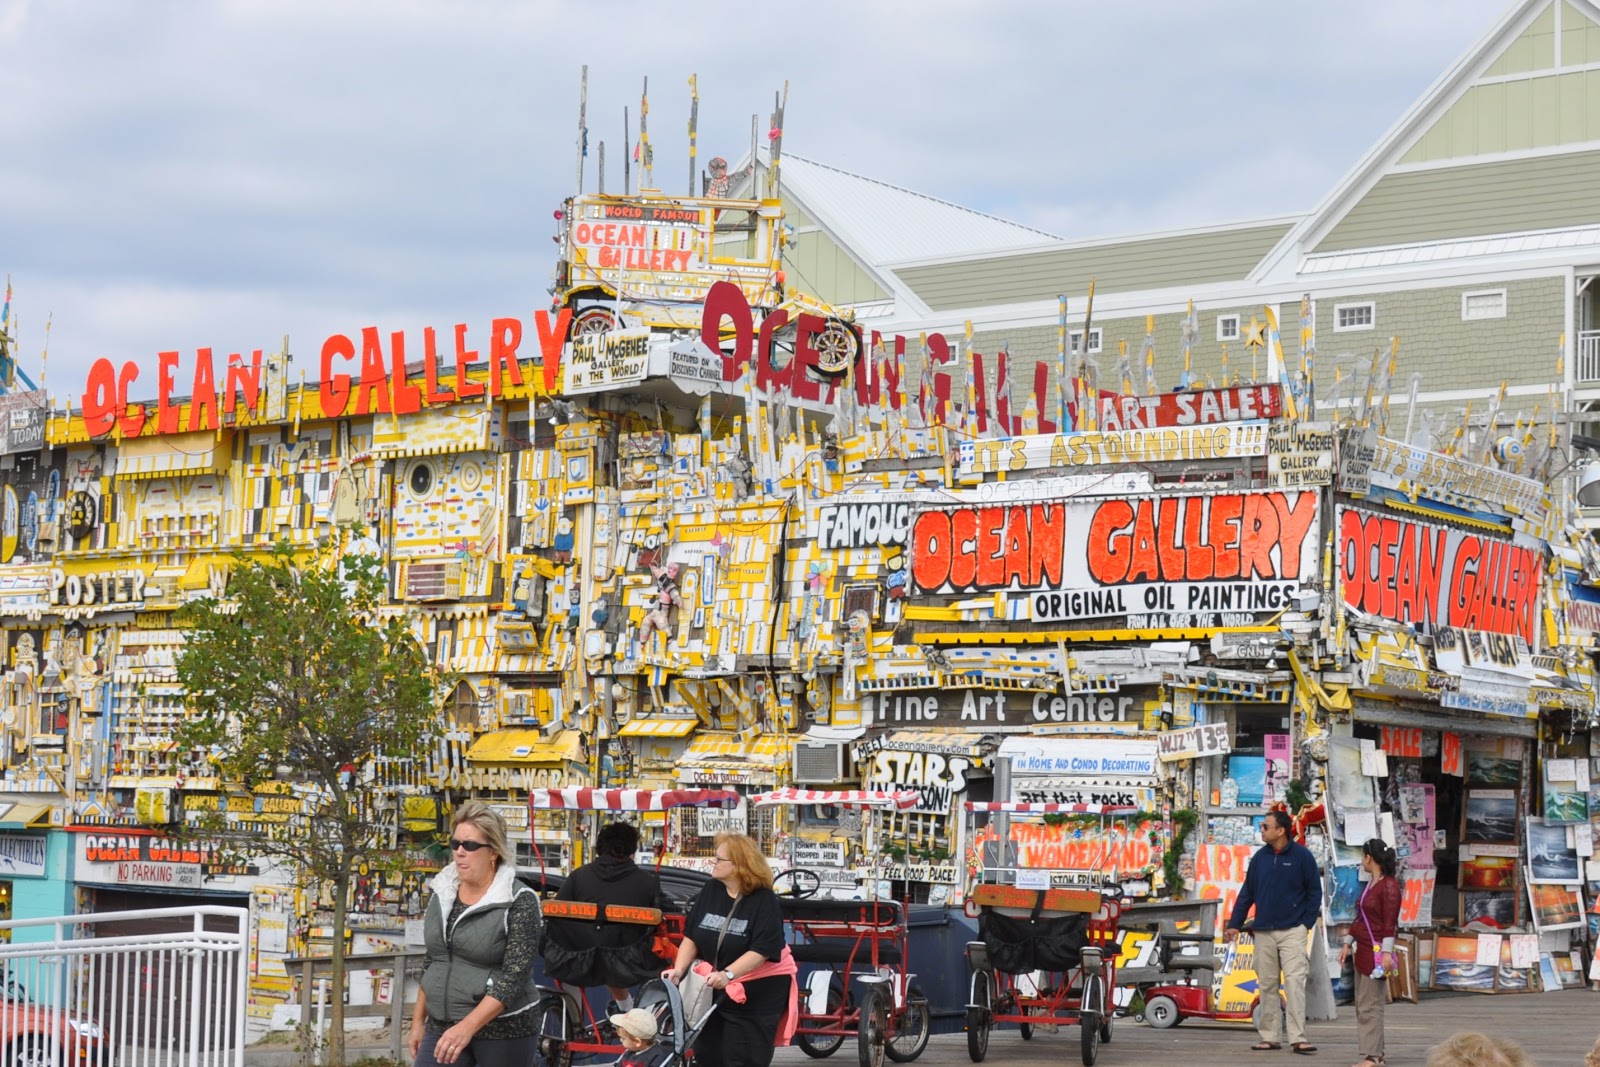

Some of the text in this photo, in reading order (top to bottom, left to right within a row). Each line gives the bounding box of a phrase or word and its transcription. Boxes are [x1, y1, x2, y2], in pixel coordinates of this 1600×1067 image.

[605, 205, 643, 219] WORLD
[576, 222, 646, 248] OCEAN
[598, 245, 692, 272] GALLERY
[572, 336, 649, 364] PAUL McGEHEE
[672, 352, 699, 365] FEATURED
[701, 358, 710, 367] ON
[319, 307, 573, 418] GALLERY
[572, 361, 645, 384] IN THE WORLD!
[590, 359, 625, 370] GALLERY
[671, 362, 699, 377] DISCOVERY
[700, 367, 722, 381] CHANNEL
[81, 347, 263, 439] OCEAN
[1101, 385, 1271, 432] ART SALE!
[12, 425, 44, 445] TODAY
[1269, 438, 1292, 453] PAUL
[1296, 433, 1332, 451] McGEHEE
[971, 424, 1262, 473] IT'S ASTOUNDING!!!
[1280, 455, 1320, 470] GALLERY
[1269, 474, 1279, 485] IN
[1284, 471, 1300, 484] THE
[1301, 469, 1332, 482] WORLD!
[818, 503, 910, 550] FAMOUS
[911, 489, 1318, 595] OCEAN GALLERY
[50, 567, 146, 607] POSTER
[1340, 509, 1543, 648] OCEAN GALLERY
[1035, 584, 1296, 618] ORIGINAL OIL PAINTINGS
[1126, 613, 1149, 630] FROM
[1195, 612, 1215, 629] THE
[1220, 611, 1255, 628] WORLD
[1237, 644, 1265, 658] CNN
[878, 689, 1134, 723] Fine Art Center
[1195, 726, 1219, 752] 13
[1381, 725, 1422, 758] SALE
[874, 750, 969, 793] STARS
[1028, 756, 1053, 770] HOME
[1054, 758, 1070, 770] AND
[1071, 756, 1099, 771] CONDO
[1101, 756, 1151, 772] DECORATING
[438, 765, 511, 791] POSTER
[694, 771, 749, 784] OCEAN GALLERY
[1020, 790, 1048, 805] art
[1091, 792, 1135, 806] rocks
[701, 816, 745, 833] NEWSWEEK
[86, 835, 141, 862] OCEAN
[823, 851, 839, 860] HERE
[1025, 840, 1150, 871] WONDERLAND
[117, 863, 173, 883] NO PARKING
[175, 866, 197, 875] LOADING
[227, 864, 249, 875] CAVE
[928, 866, 957, 882] PLACE!
[1194, 843, 1251, 884] ART
[178, 875, 193, 885] AREA
[1401, 877, 1423, 923] 90
